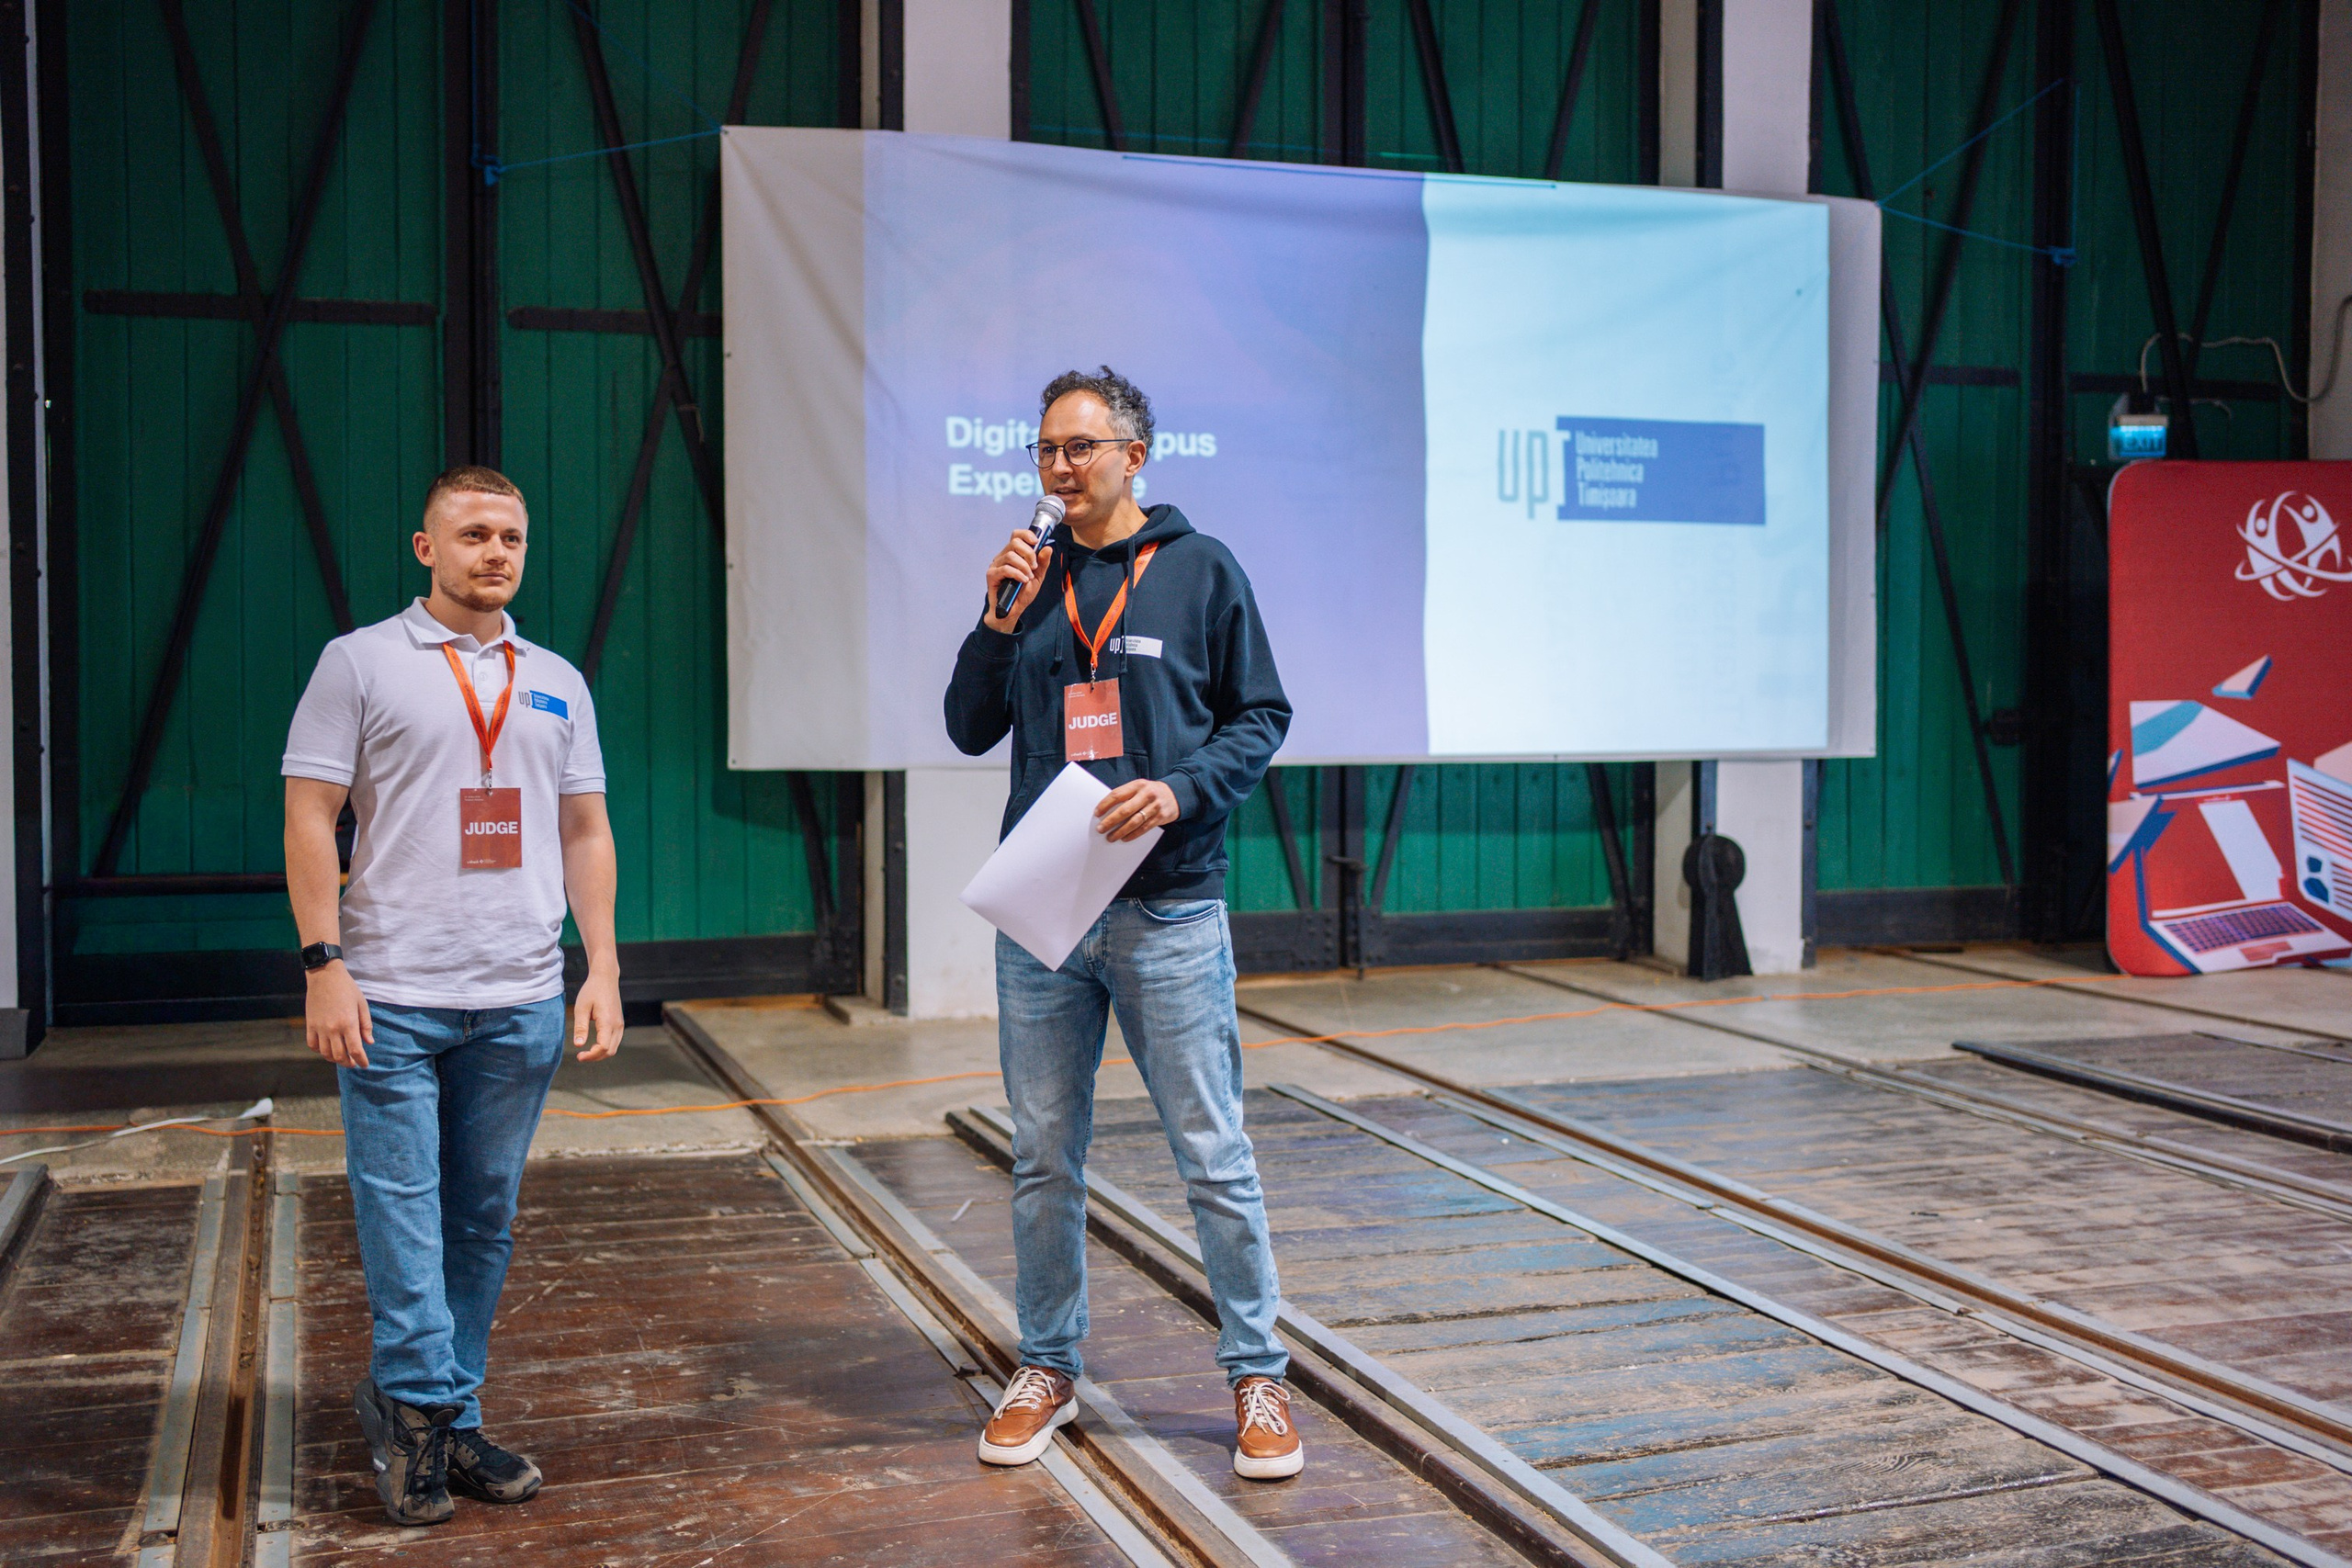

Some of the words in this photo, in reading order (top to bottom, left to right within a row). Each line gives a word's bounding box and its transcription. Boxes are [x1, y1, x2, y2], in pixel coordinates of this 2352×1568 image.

[945, 416, 1040, 457] Digit
[1153, 431, 1218, 461] pus
[1069, 712, 1118, 730] JUDGE
[464, 821, 519, 836] JUDGE
